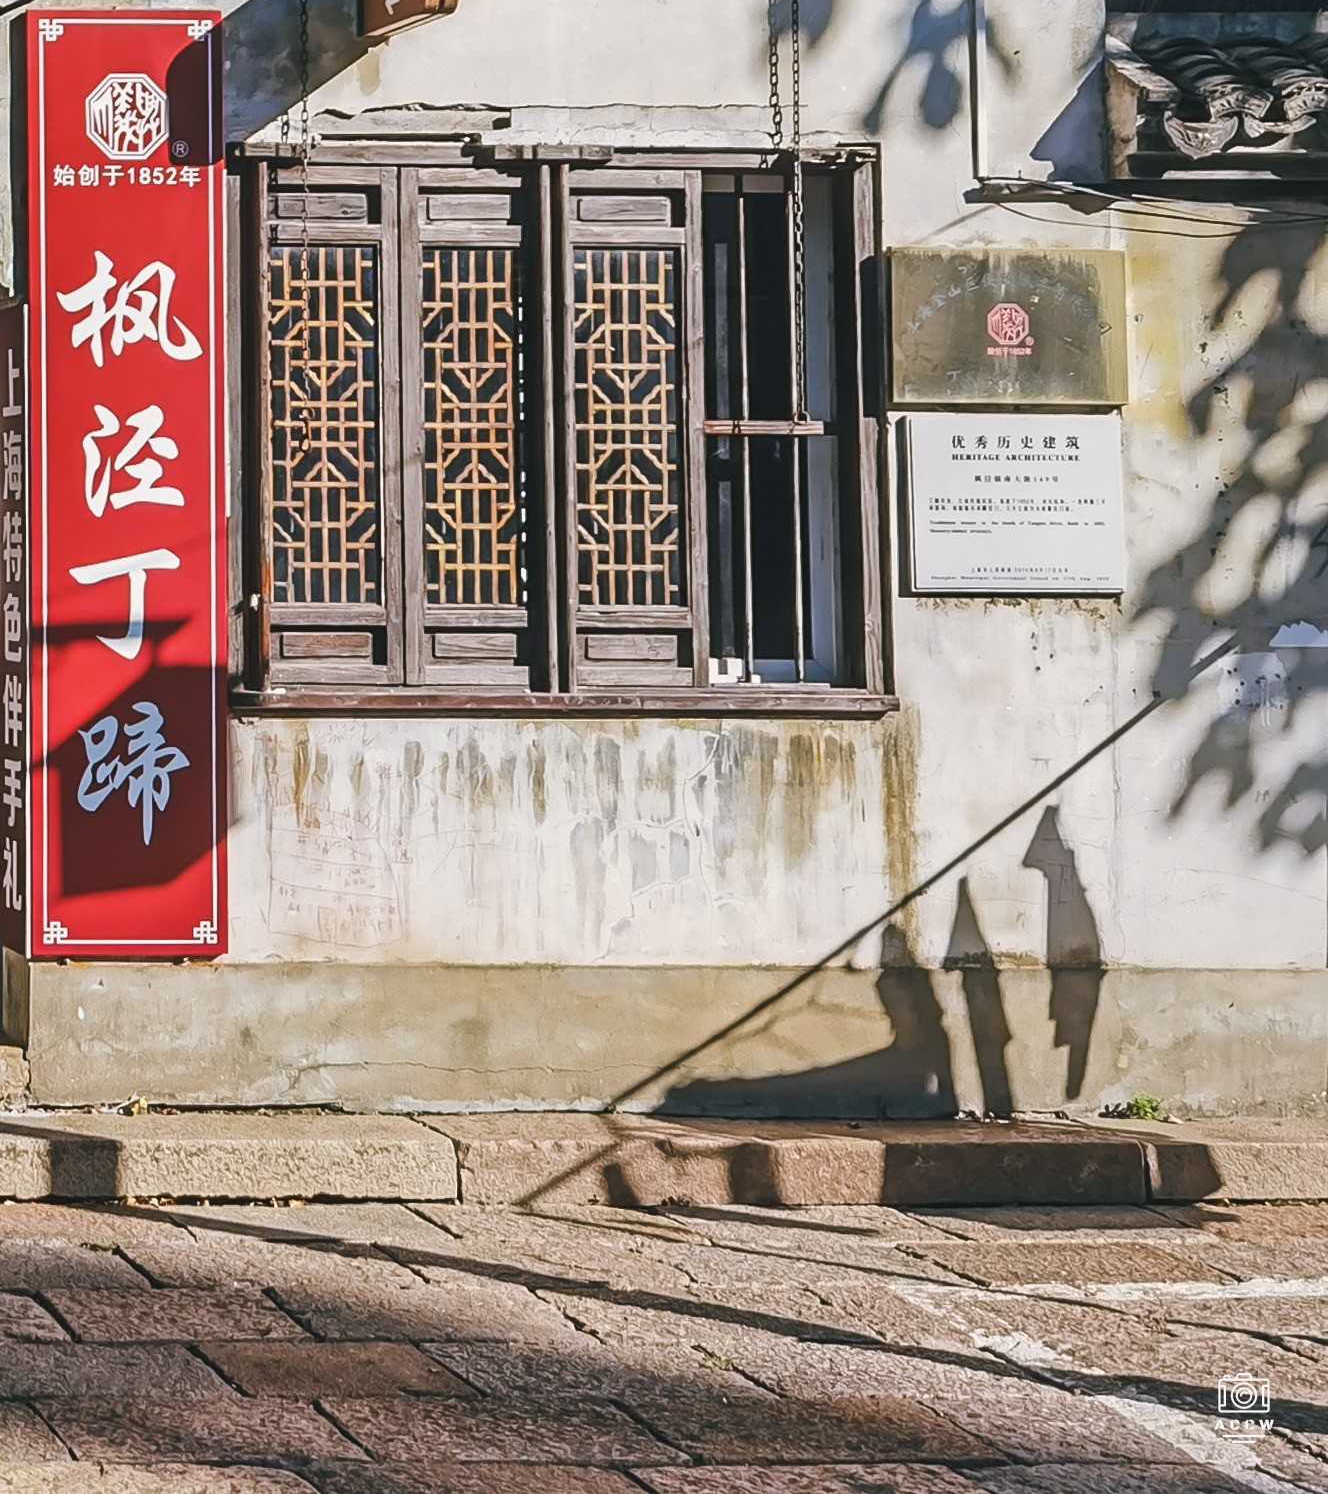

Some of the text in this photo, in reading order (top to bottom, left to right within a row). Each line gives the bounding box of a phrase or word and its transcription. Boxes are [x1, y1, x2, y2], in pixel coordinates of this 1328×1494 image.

[53, 164, 202, 188] 始创于1852年
[951, 435, 1080, 449] 优秀历史建筑
[951, 453, 1081, 461] HERITAGE ARCHITECTURE
[55, 250, 203, 846] 枫泾丁蹄
[1, 348, 23, 911] 上海特色伴手礼
